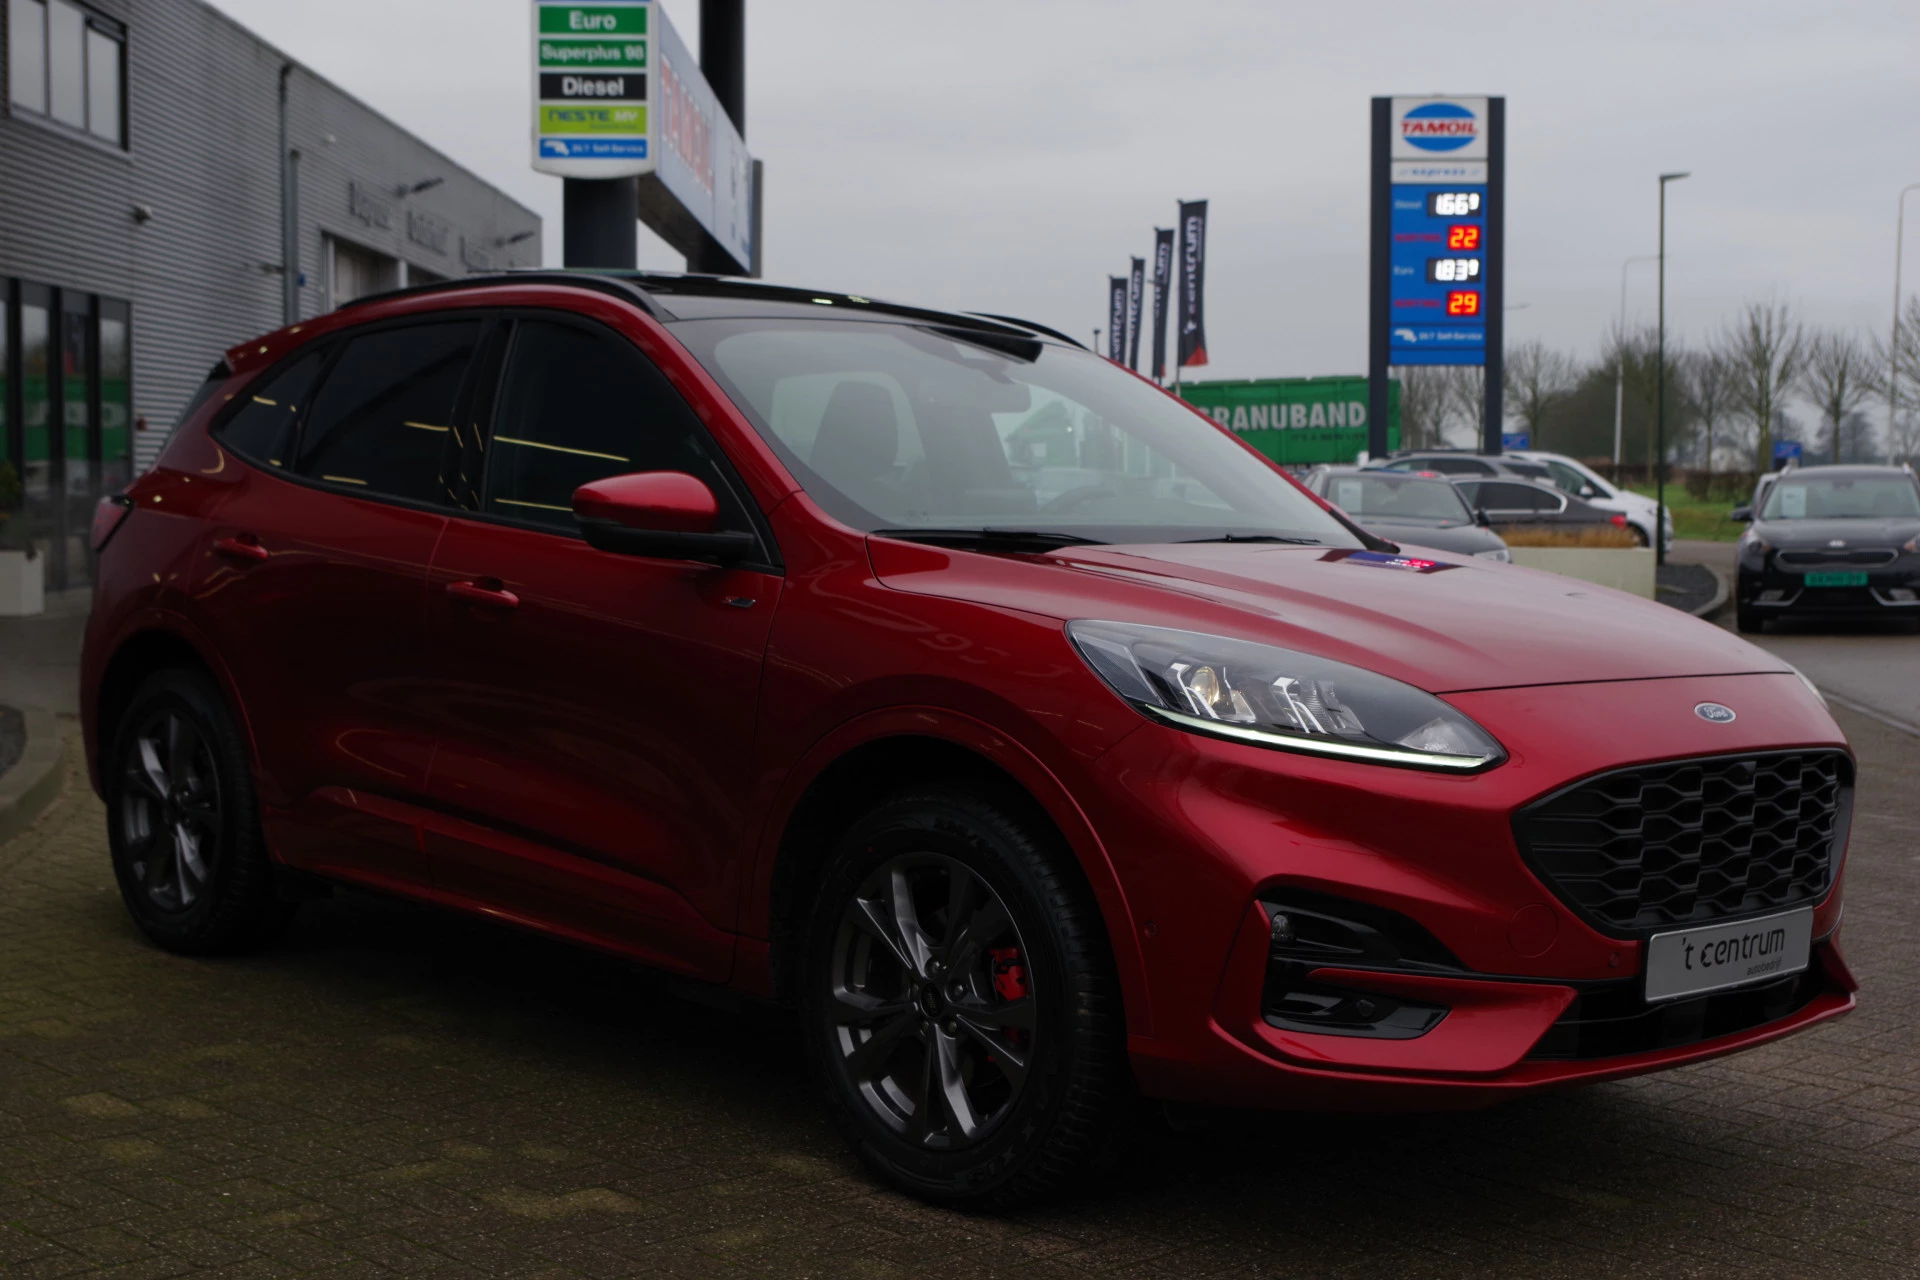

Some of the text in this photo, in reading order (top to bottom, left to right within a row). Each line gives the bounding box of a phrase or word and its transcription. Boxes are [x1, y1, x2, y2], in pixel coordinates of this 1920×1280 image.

[569, 10, 617, 30] Euro
[541, 44, 644, 63] Superplus 98
[562, 77, 624, 96] Diesel
[1401, 120, 1478, 136] TAMOIL
[1449, 226, 1479, 249] 22
[1449, 293, 1478, 315] 29
[1701, 928, 1785, 967] centrum
